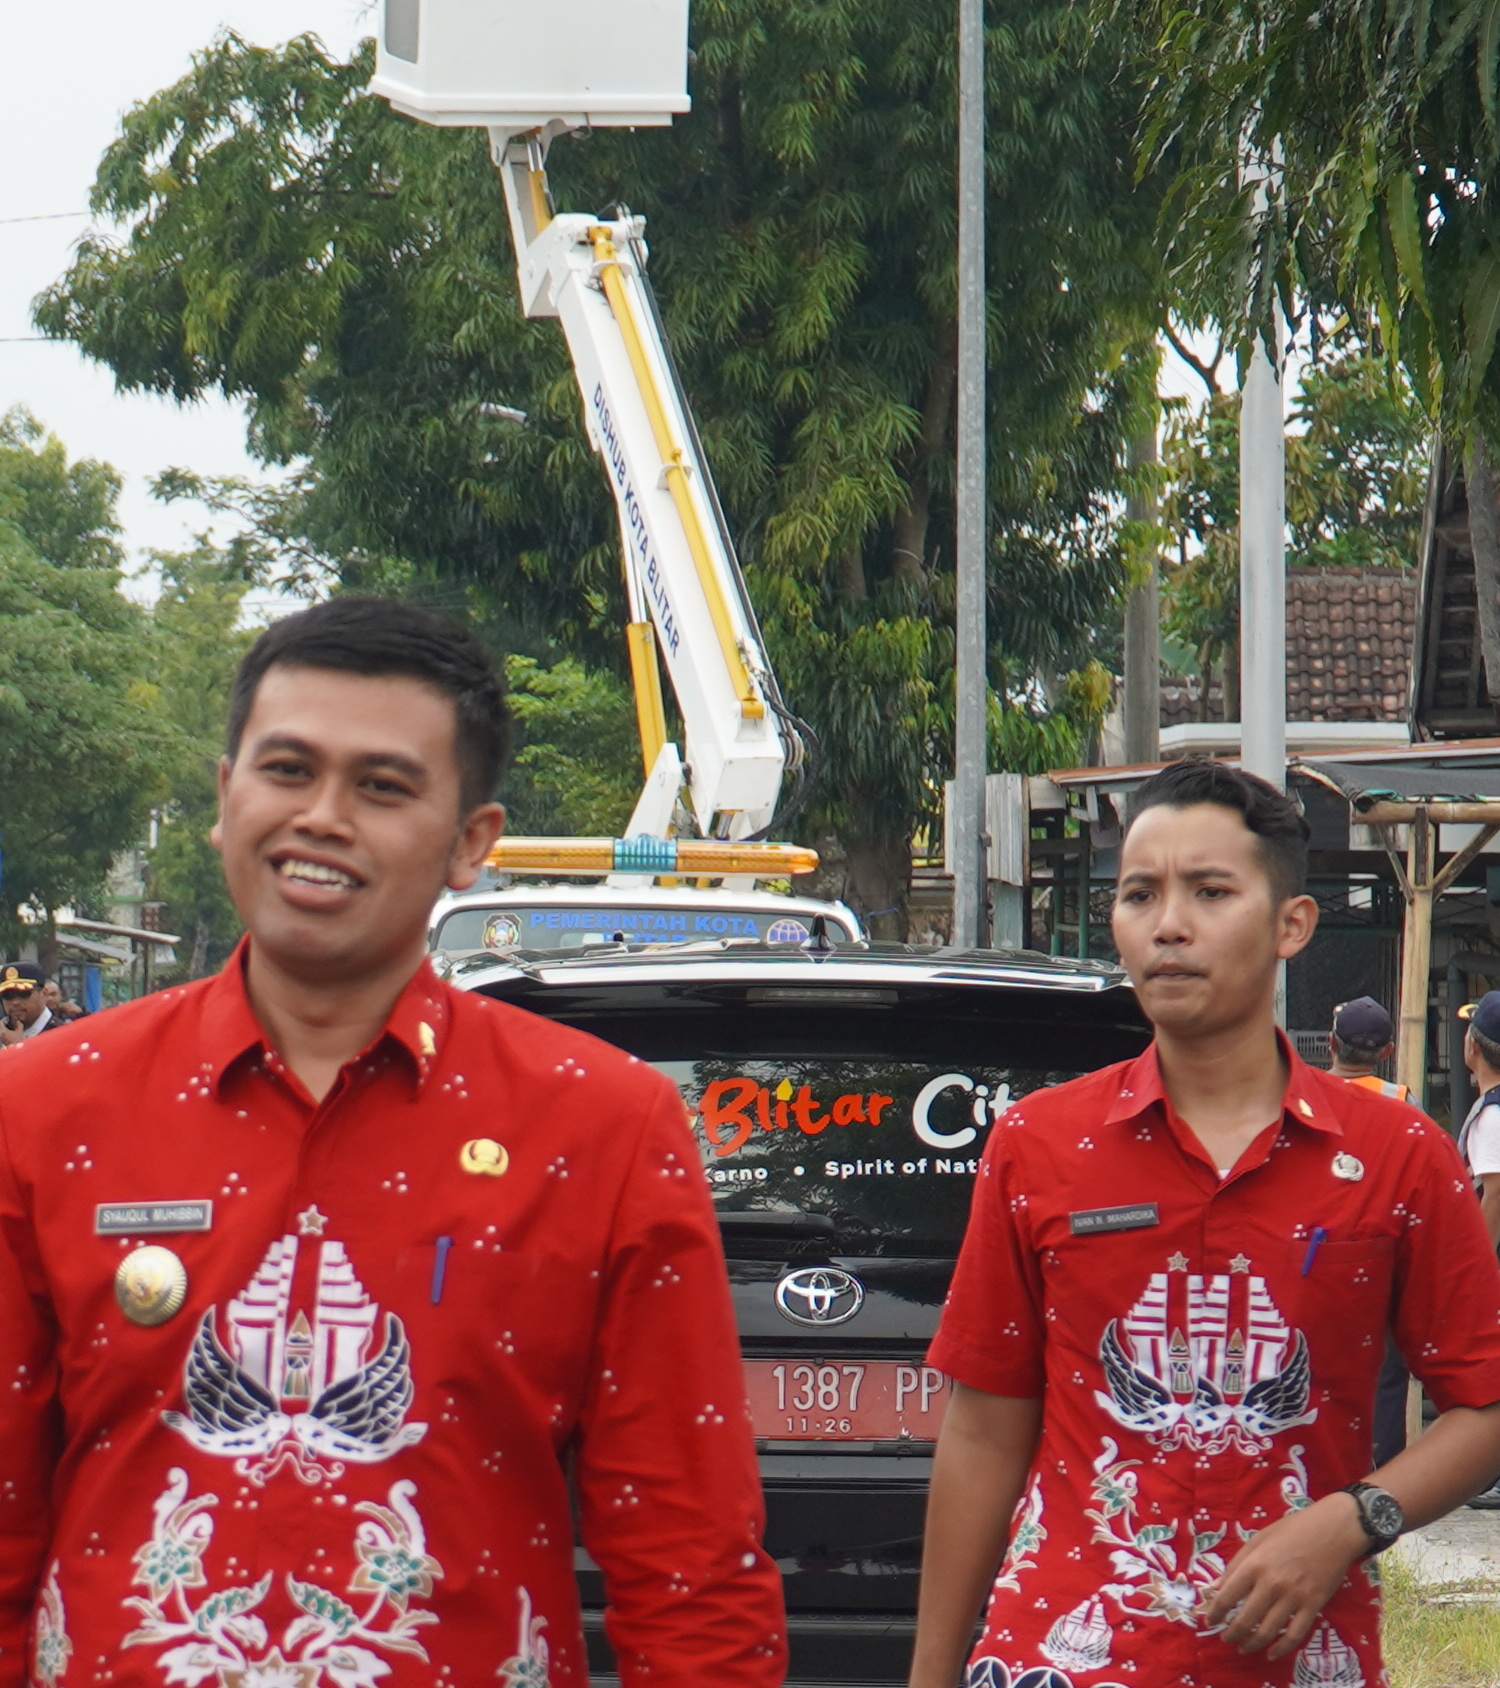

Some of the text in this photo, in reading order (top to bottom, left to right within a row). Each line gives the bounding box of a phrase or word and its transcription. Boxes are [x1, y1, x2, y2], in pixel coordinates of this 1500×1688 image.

[593, 380, 681, 659] DISHUB KOTA BLITAR
[530, 913, 758, 937] PEMERINTAH KOTA
[700, 1073, 1016, 1157] Blitar Cit
[825, 1159, 894, 1179] Spirit
[902, 1158, 927, 1174] of
[102, 1207, 203, 1223] SYAUQUL MUHIBBIN
[1106, 1210, 1156, 1224] MAHARDIKA
[772, 1365, 945, 1412] 1387 PP
